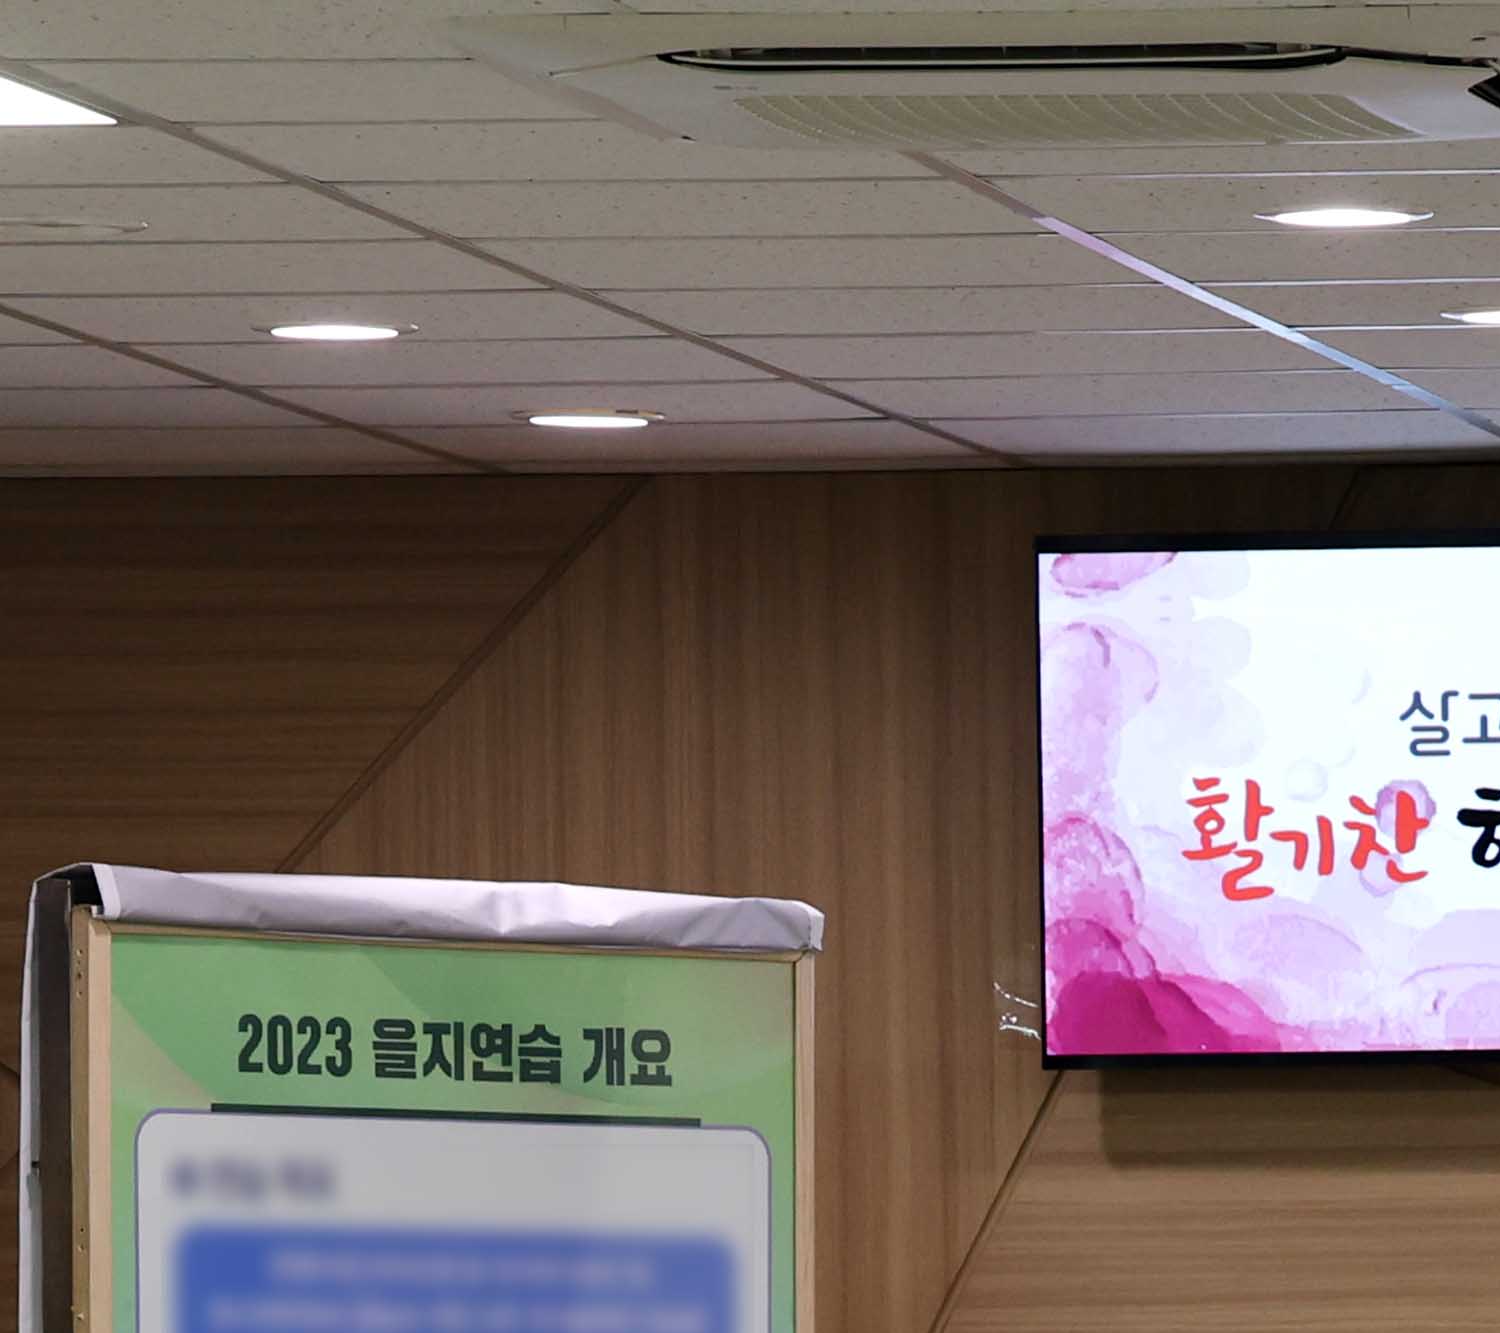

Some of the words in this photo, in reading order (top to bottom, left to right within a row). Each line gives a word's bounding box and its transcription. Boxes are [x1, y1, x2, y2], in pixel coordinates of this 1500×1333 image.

[1181, 778, 1431, 903] 활기찬
[237, 1013, 353, 1078] 2023
[371, 1018, 563, 1085] 을지연습
[582, 1026, 673, 1088] 개요
